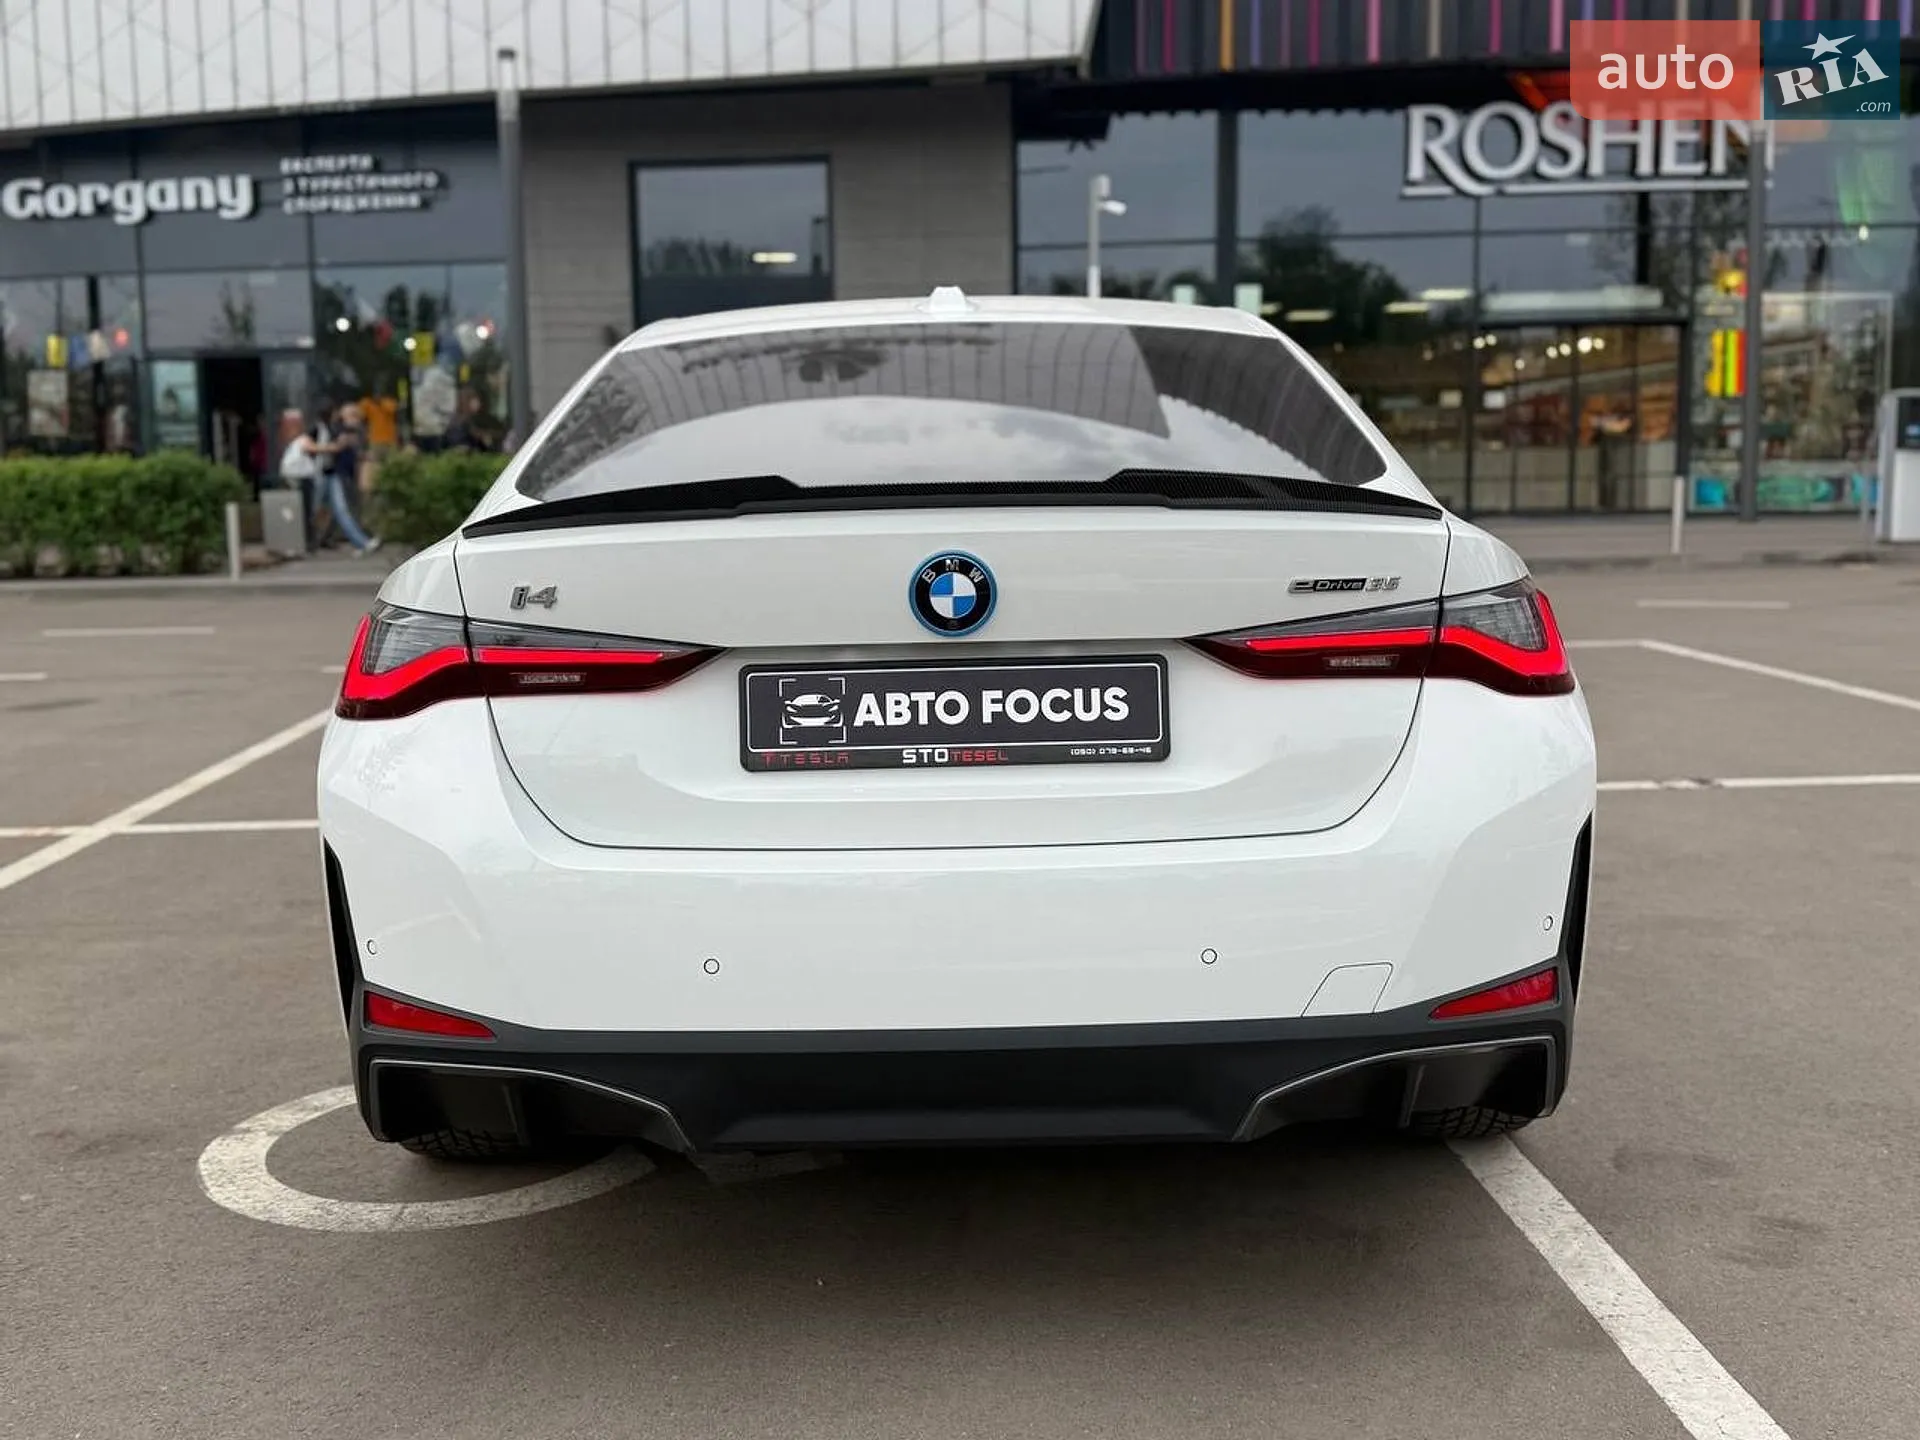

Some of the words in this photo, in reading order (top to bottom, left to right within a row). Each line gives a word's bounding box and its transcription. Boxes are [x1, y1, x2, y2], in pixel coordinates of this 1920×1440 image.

[1404, 101, 1776, 197] ROSHEN
[1, 174, 253, 226] Gorgany
[921, 558, 985, 584] BMW
[509, 585, 558, 610] i4
[981, 686, 1129, 725] FOCUS
